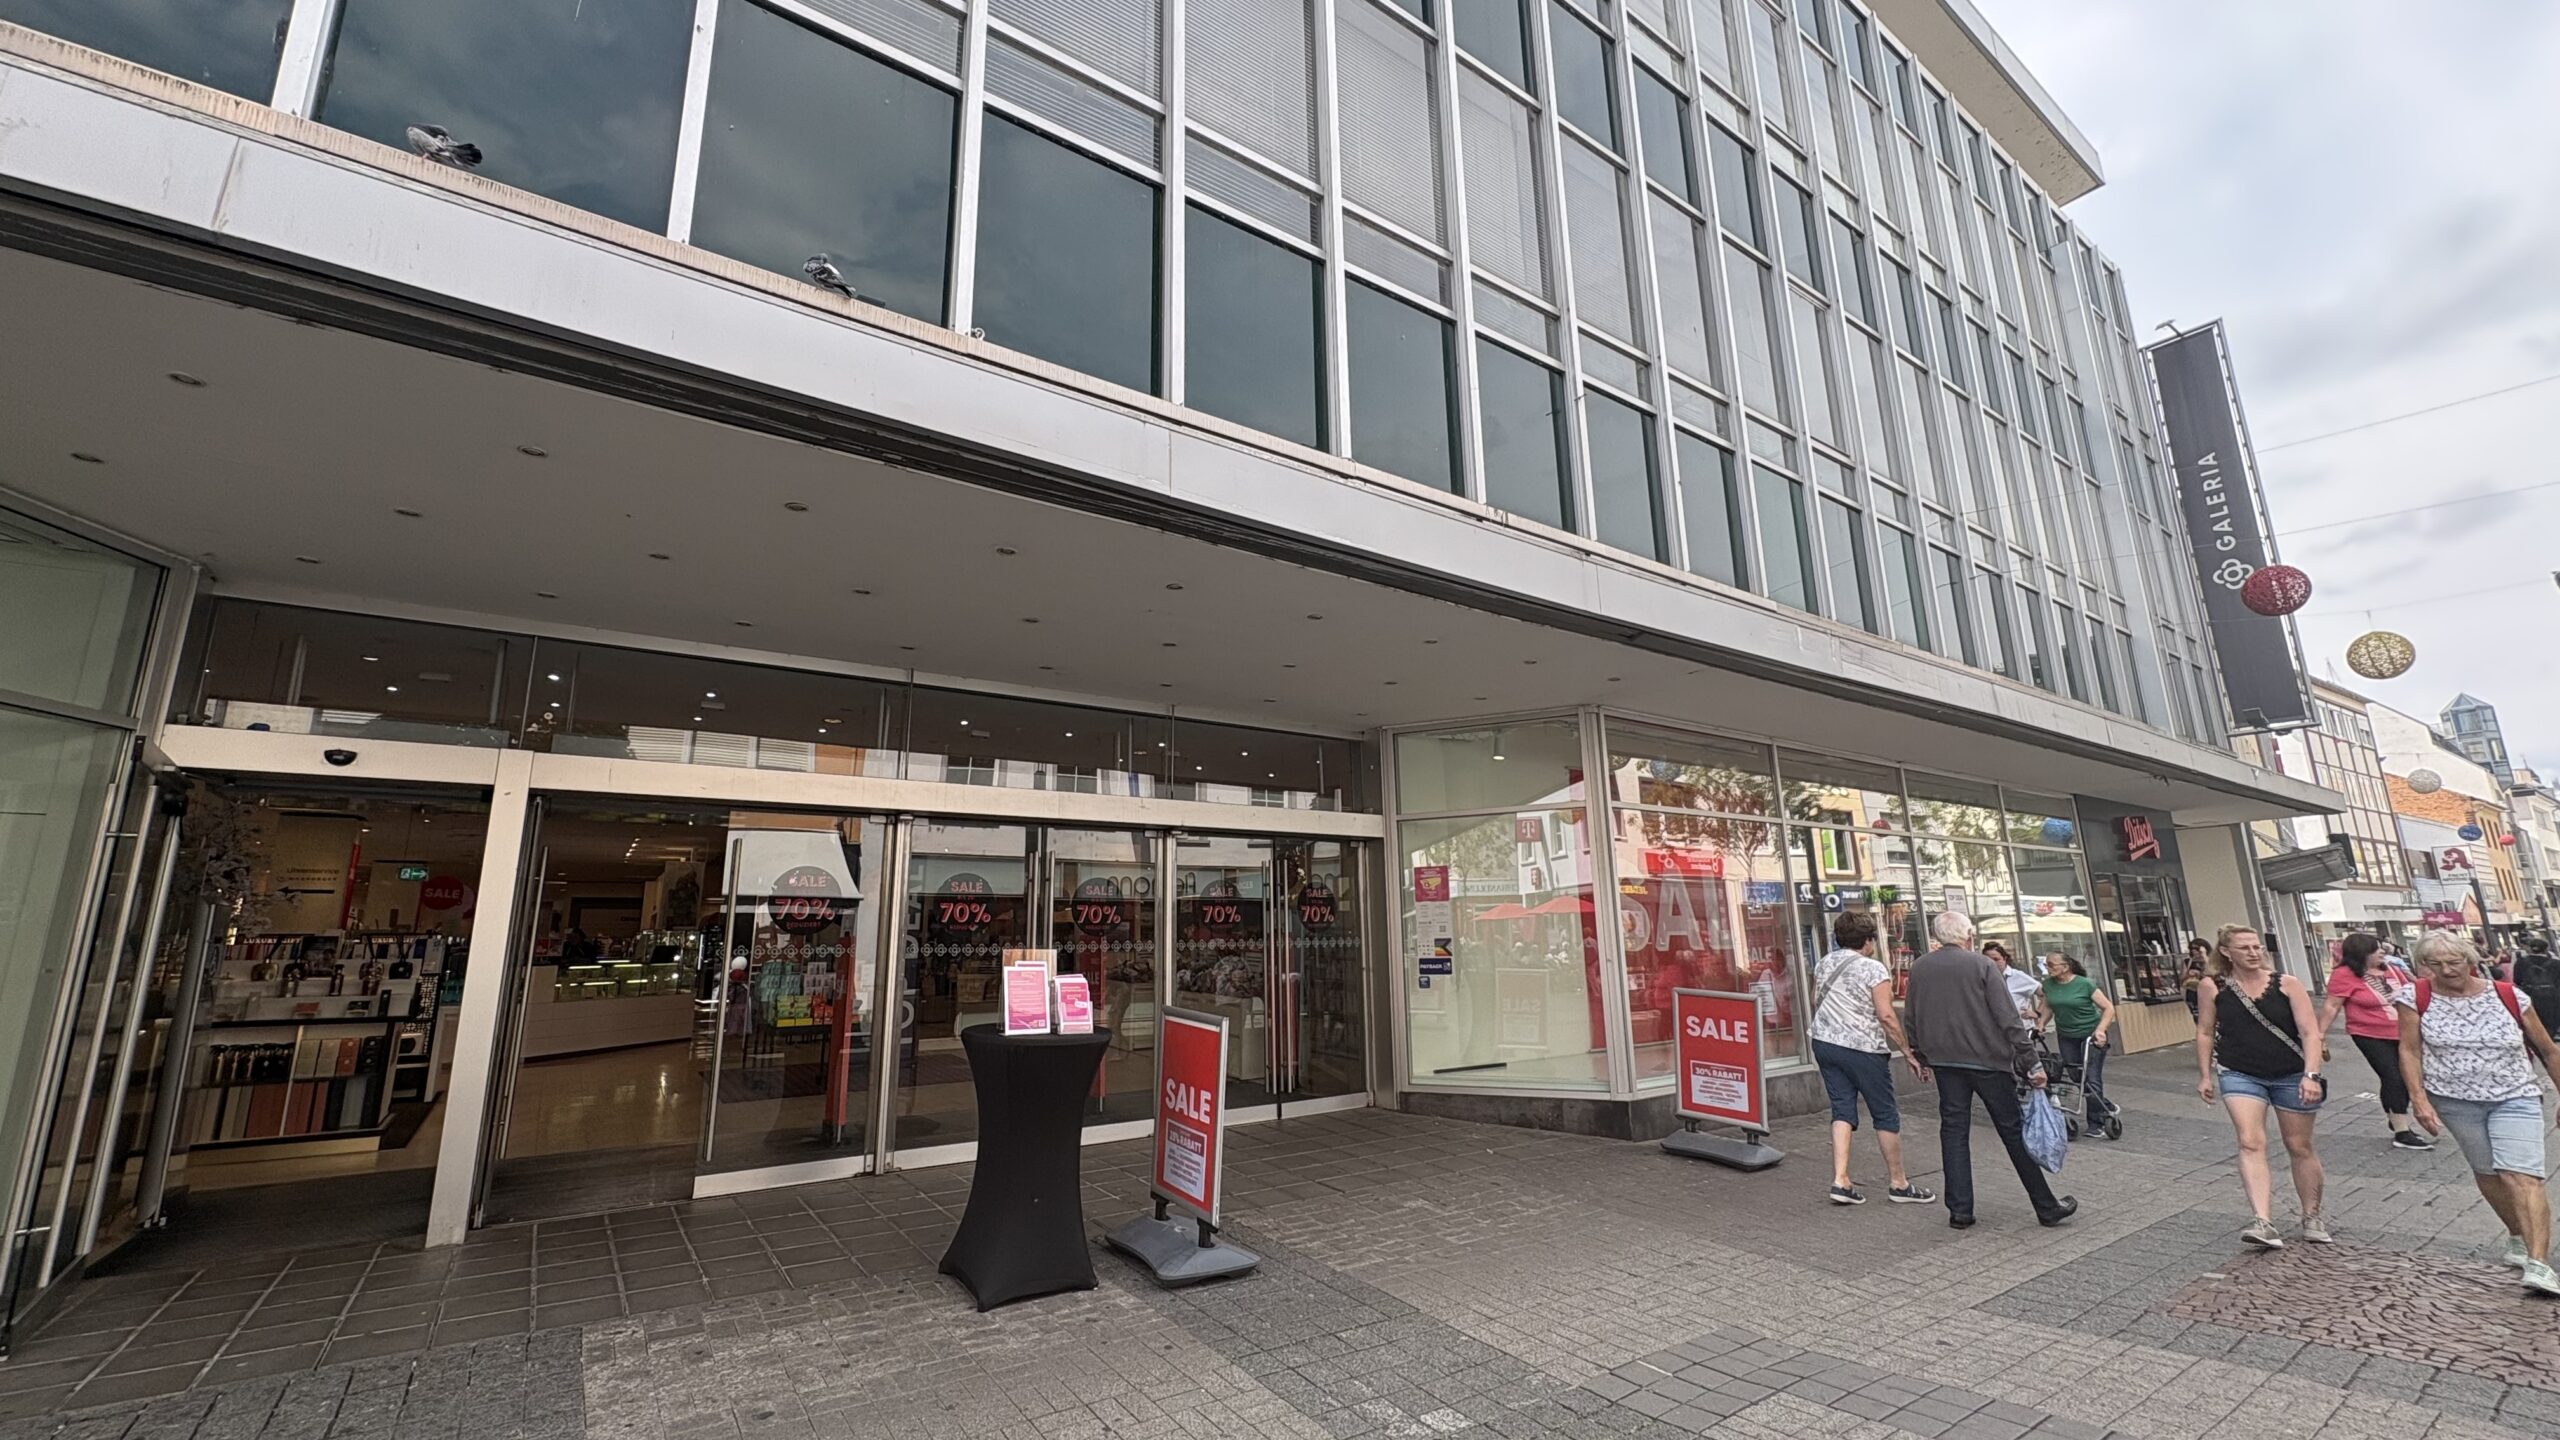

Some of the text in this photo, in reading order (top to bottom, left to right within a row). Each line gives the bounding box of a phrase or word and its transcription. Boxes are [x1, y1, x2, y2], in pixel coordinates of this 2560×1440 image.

[2197, 451, 2236, 551] GALERIA
[2124, 816, 2161, 861] Ditsch
[424, 887, 462, 899] SALE
[950, 881, 983, 893] SALE
[1085, 885, 1114, 896] SALE
[1306, 888, 1329, 898] SALE
[775, 898, 836, 920] 70%
[939, 902, 992, 924] 70%
[1076, 904, 1122, 924] 70%
[1202, 905, 1242, 923] 70%
[1301, 905, 1335, 922] 70%
[1686, 1015, 1749, 1044] SALE
[1712, 1069, 1743, 1080] RABATT
[1166, 1078, 1212, 1125] SALE
[1180, 1135, 1202, 1154] RABATT
